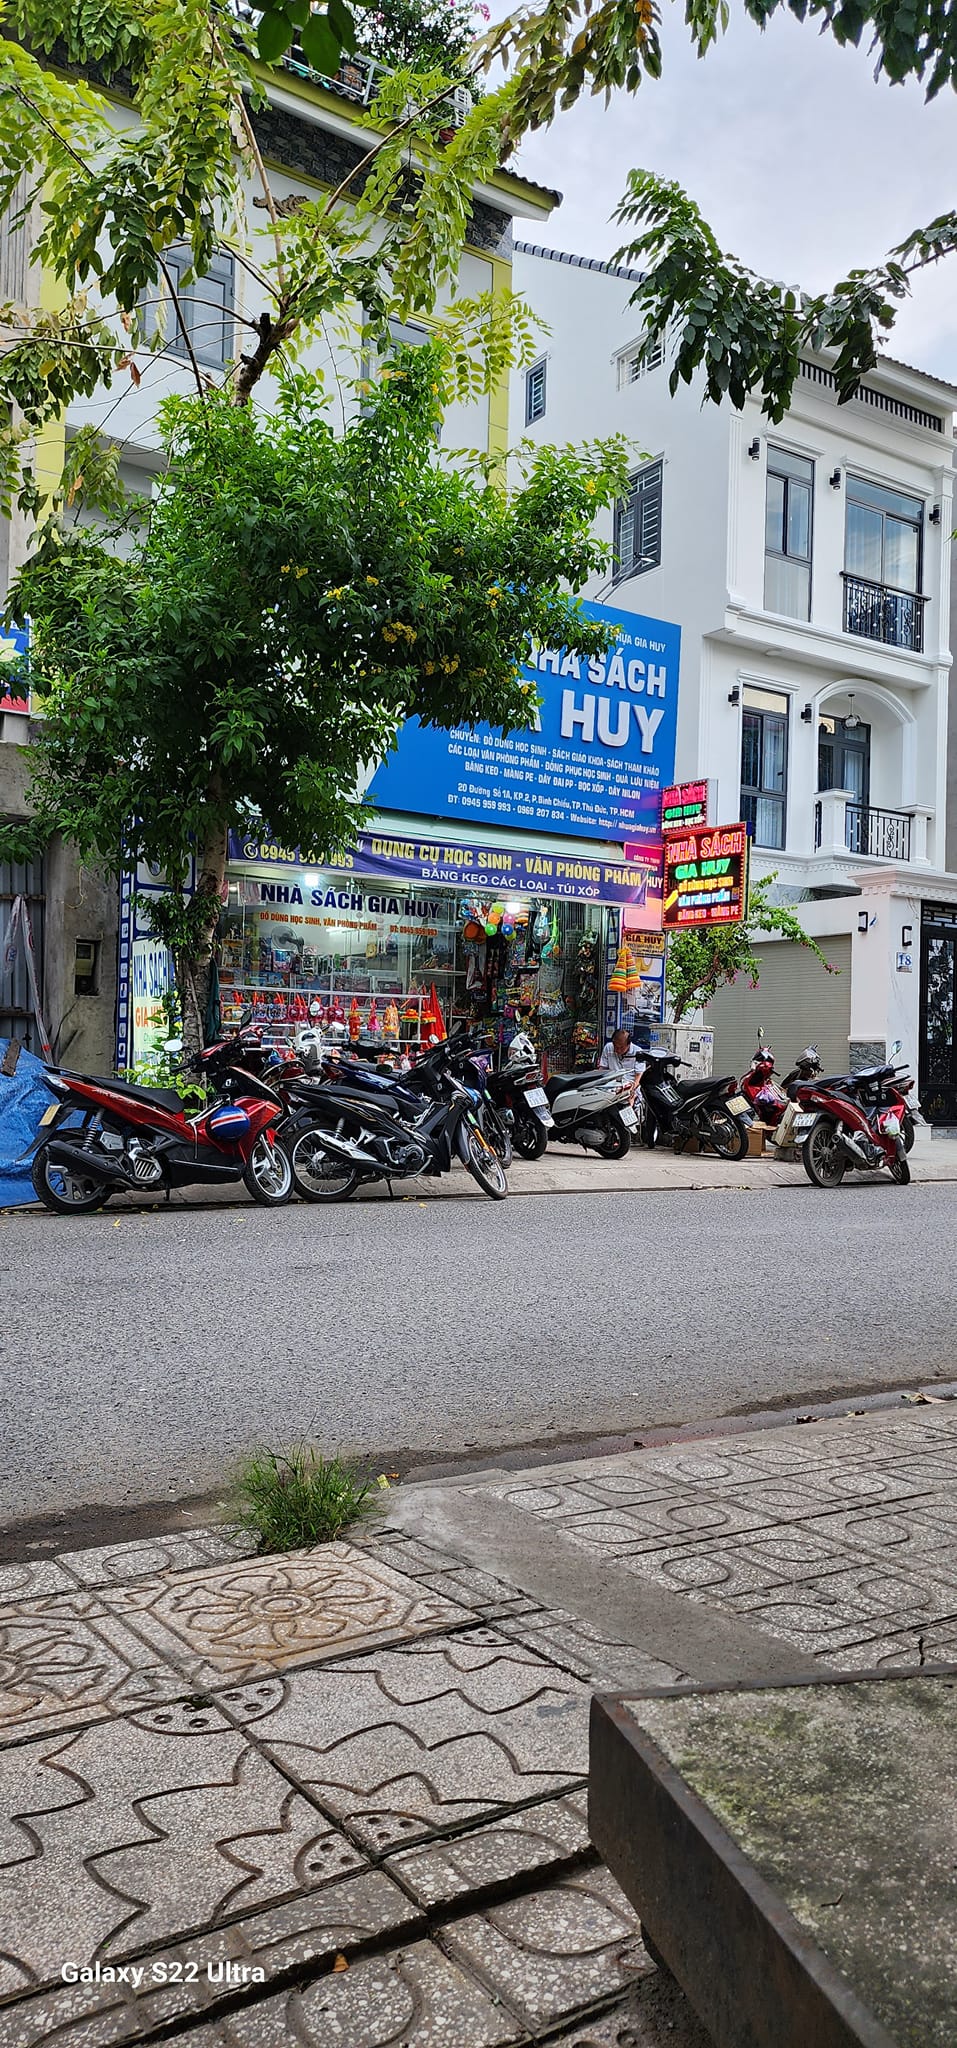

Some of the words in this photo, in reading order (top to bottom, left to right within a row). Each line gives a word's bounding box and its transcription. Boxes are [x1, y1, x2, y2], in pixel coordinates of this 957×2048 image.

[614, 632, 632, 646] HỰA
[634, 634, 648, 649] GIA
[649, 640, 667, 653] HUY
[587, 648, 667, 698] SÁCH
[560, 689, 665, 754] HUY
[448, 742, 462, 755] CÁC
[463, 746, 480, 760] LOẠI
[496, 752, 519, 765] PHÒNG
[565, 764, 582, 778] PHỤC
[583, 768, 596, 780] HỌC
[596, 770, 612, 781] SINH
[515, 741, 529, 754] HỌC
[530, 744, 547, 757] SINH
[552, 747, 571, 760] SÁCH
[571, 751, 587, 764] GIÁO
[606, 758, 623, 770] SÁCH
[624, 762, 642, 773] THAM
[485, 764, 499, 776] KEO
[525, 772, 534, 782] PE
[565, 778, 574, 789] PP
[578, 781, 591, 792] BỌC
[621, 788, 641, 800] NILON
[447, 793, 461, 804] ĐT:
[461, 796, 481, 808] 0945
[482, 799, 496, 810] 959
[497, 801, 511, 812] 993
[517, 804, 535, 816] 0969
[536, 807, 549, 818] 207
[551, 810, 565, 820] 834
[457, 782, 468, 793] 20
[492, 785, 502, 797] Số
[502, 789, 513, 800] 1A,
[609, 806, 635, 819] TP.HCM
[665, 806, 682, 819] GIA
[371, 838, 416, 860] DỤNG
[418, 845, 440, 865] CỤ
[443, 848, 473, 869] HỌC
[477, 851, 513, 871] SINH
[524, 855, 553, 876] VĂN
[555, 860, 600, 882] PHÒNG
[604, 866, 642, 887] PHẨM
[667, 836, 697, 864] NHÀ
[700, 831, 742, 859] SÁCH
[421, 867, 458, 881] BĂNG
[462, 871, 488, 884] KEO
[491, 874, 517, 888] CÁC
[519, 879, 547, 893] LOẠI
[556, 882, 575, 895] TÚI
[577, 884, 600, 897] XỐP
[647, 876, 664, 889] HUY
[675, 863, 698, 879] GIA
[701, 858, 731, 876] HUY
[260, 883, 304, 905] NHÀ
[311, 887, 363, 912] SÁCH
[368, 895, 400, 915] GIA
[404, 899, 440, 919] HUY
[270, 911, 288, 923] DÙNG
[290, 914, 303, 925] HỌC
[337, 919, 358, 930] PHÒNG
[625, 934, 641, 943] GIA
[643, 935, 662, 945] HUY
[899, 955, 912, 966] 18
[135, 1006, 149, 1028] GIA
